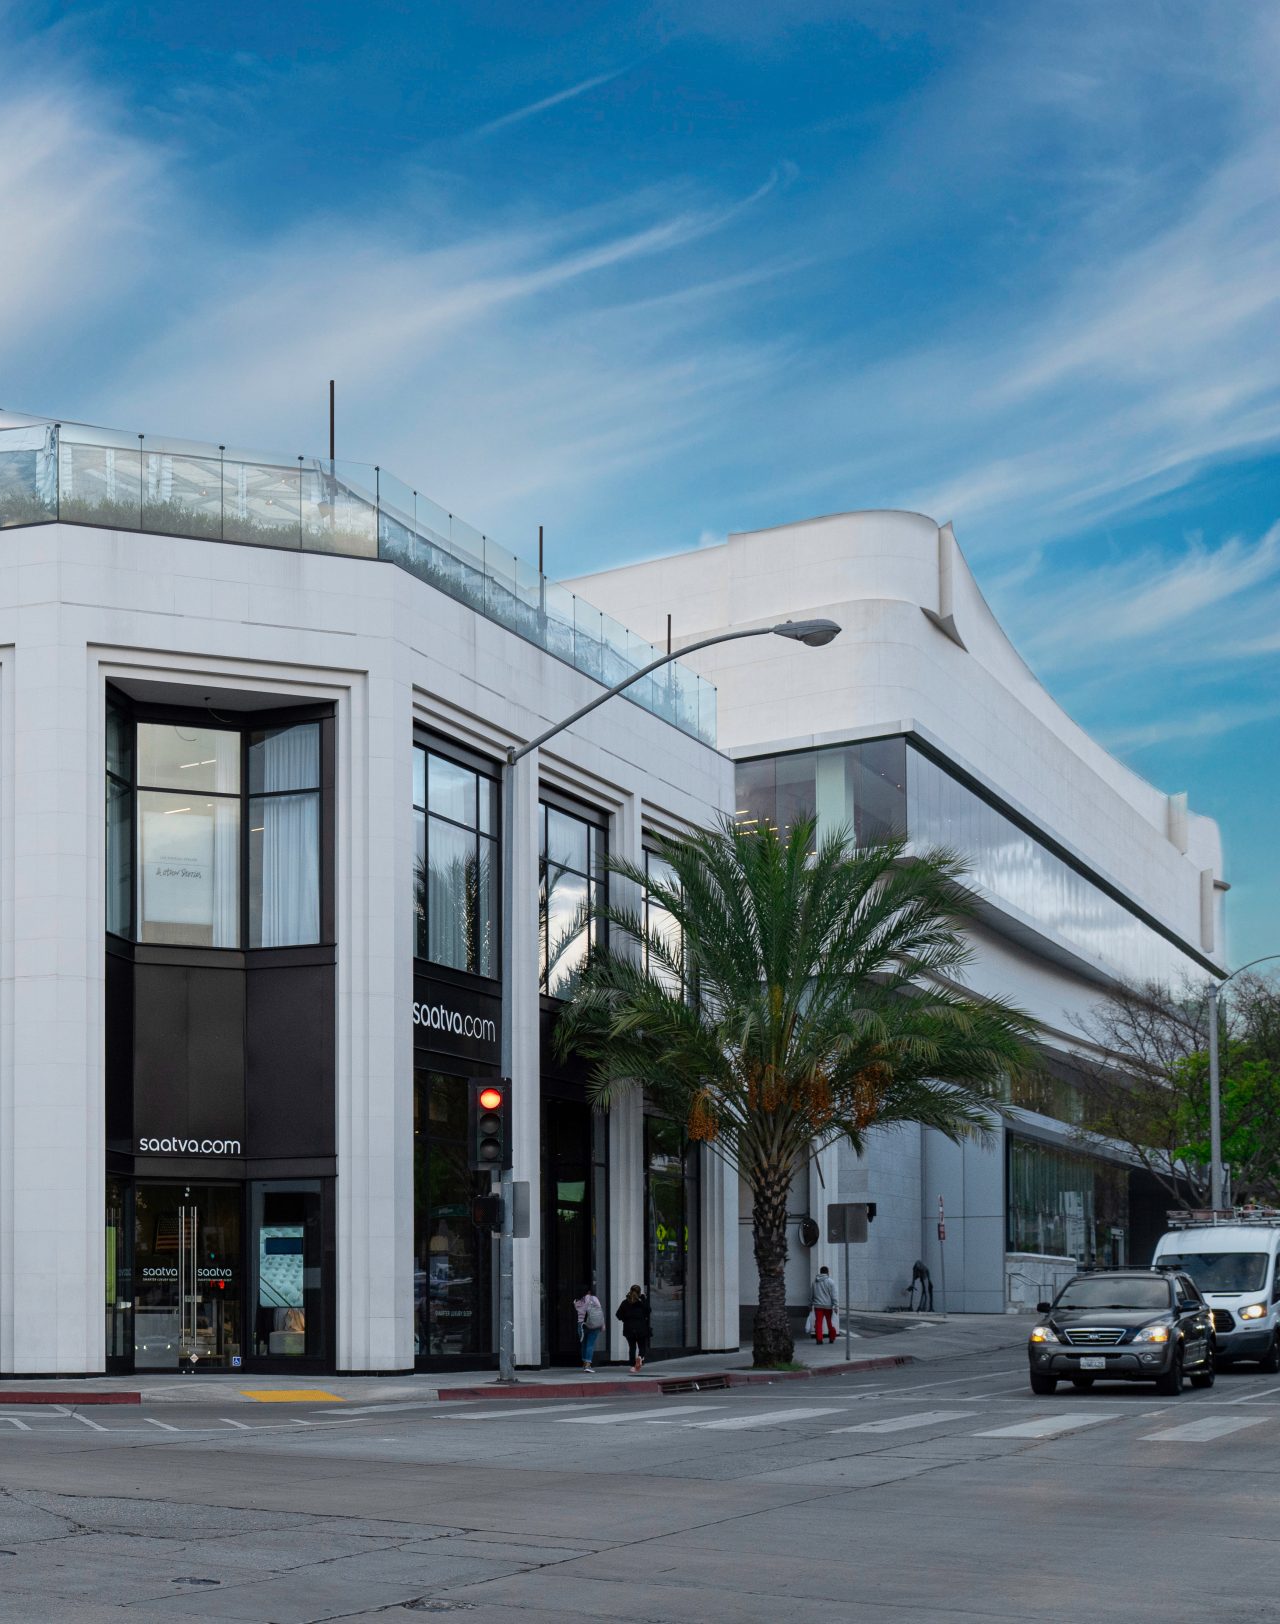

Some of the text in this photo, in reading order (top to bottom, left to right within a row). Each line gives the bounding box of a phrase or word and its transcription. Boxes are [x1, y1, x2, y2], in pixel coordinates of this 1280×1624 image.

[413, 1002, 496, 1043] saatva.com
[139, 1136, 241, 1155] saatva.com
[142, 1267, 178, 1277] saatva
[197, 1267, 233, 1277] saatva
